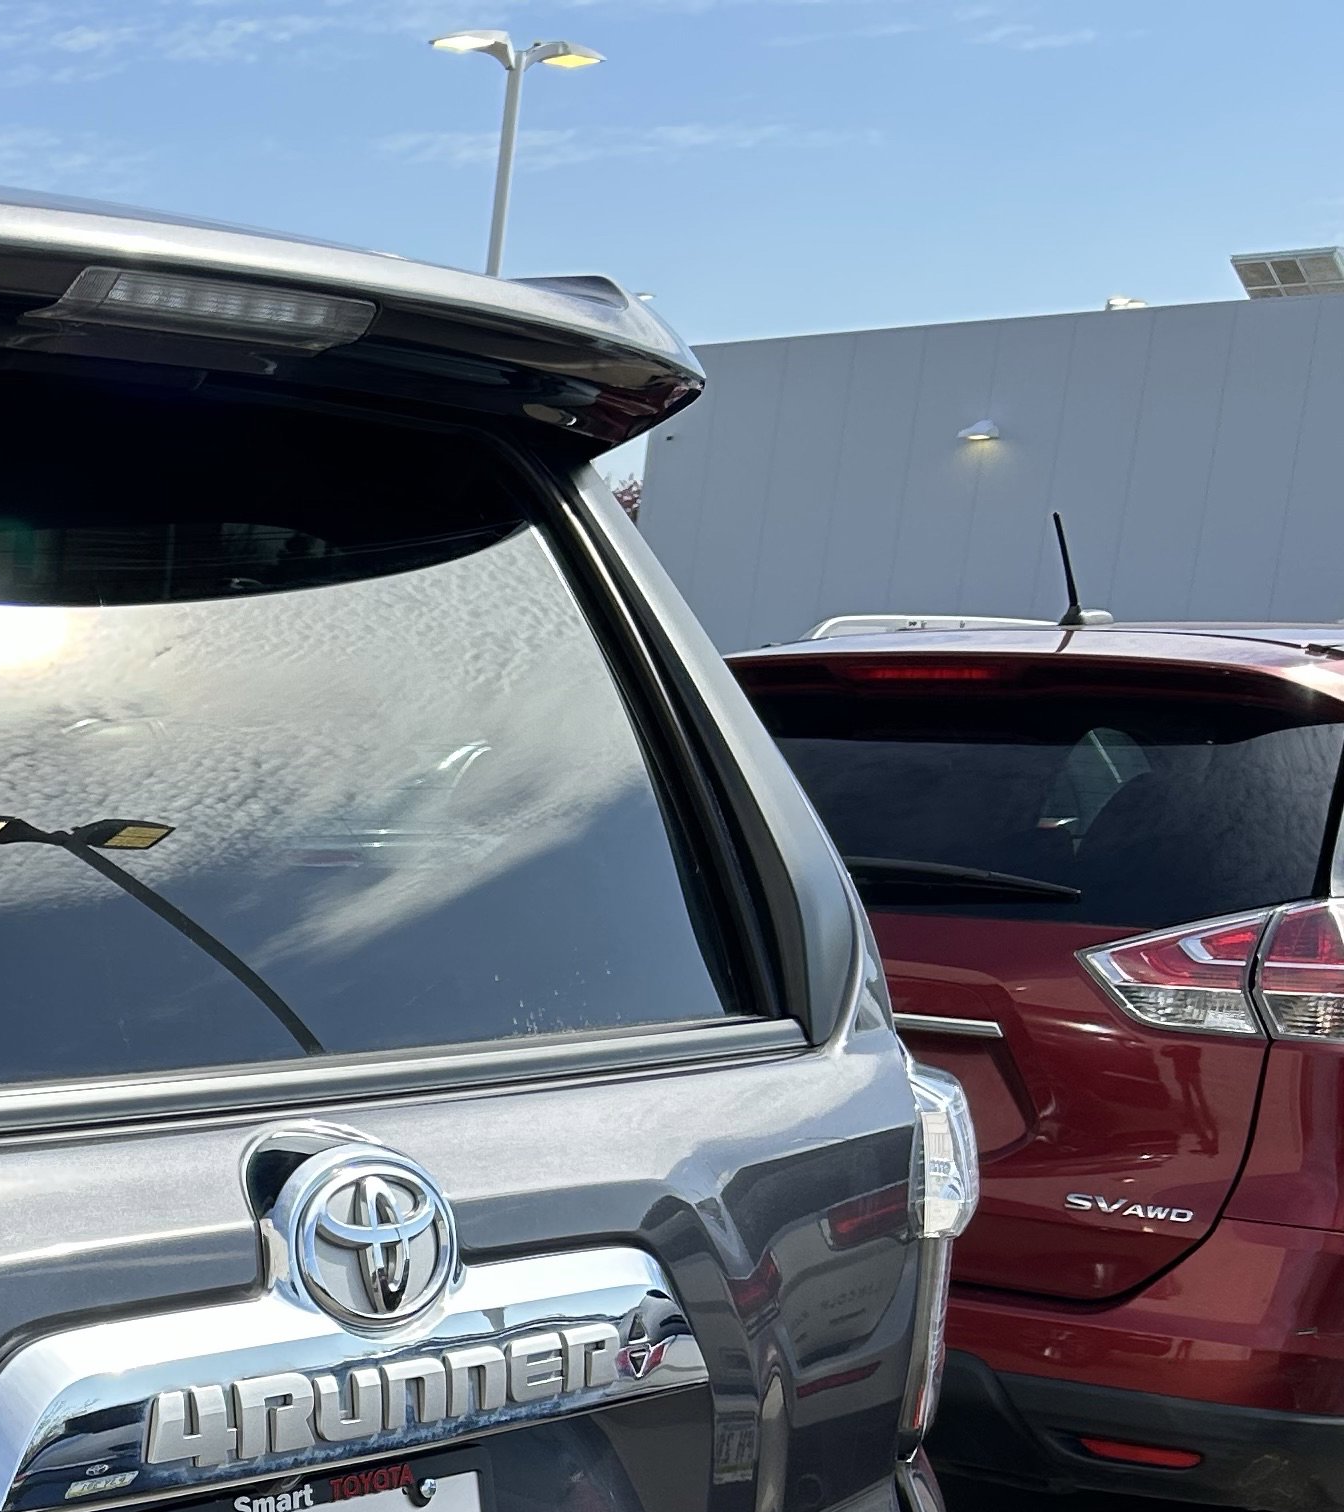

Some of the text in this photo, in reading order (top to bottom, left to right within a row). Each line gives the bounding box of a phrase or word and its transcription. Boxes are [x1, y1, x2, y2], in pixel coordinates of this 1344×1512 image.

[1064, 1192, 1194, 1223] SV AWD
[330, 1463, 416, 1501] TOYOTA
